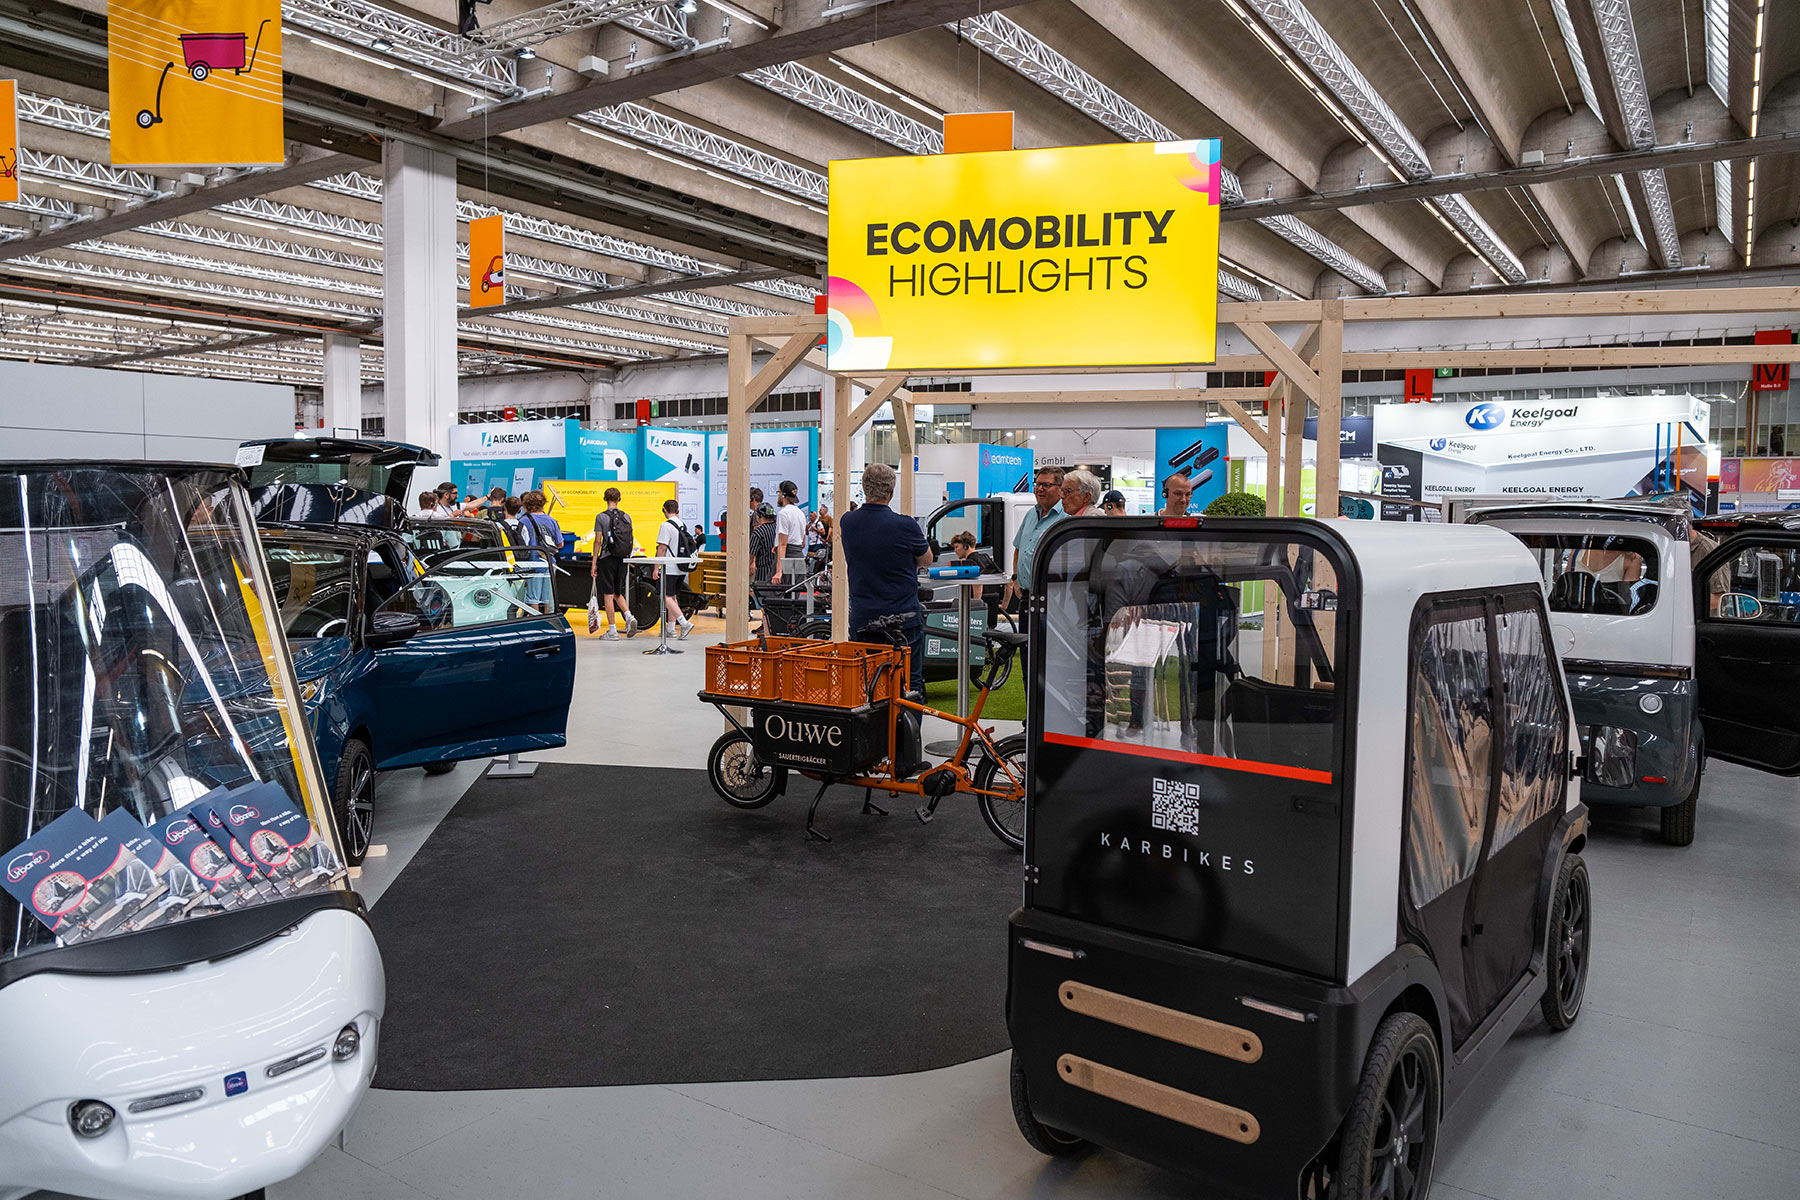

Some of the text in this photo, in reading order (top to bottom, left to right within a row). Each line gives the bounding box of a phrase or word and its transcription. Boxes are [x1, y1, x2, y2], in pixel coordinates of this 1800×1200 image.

[866, 209, 1176, 256] ECOMOBILITY
[889, 255, 1148, 297] HIGHLIGHTS
[1756, 364, 1786, 382] M
[1412, 376, 1426, 396] L
[1512, 406, 1578, 420] Keelgoal
[1510, 420, 1544, 428] Energy
[492, 434, 530, 444] AIKEMA
[1340, 430, 1356, 440] CM
[750, 446, 798, 457] EMA TSE
[1448, 440, 1476, 451] Keelgoal
[1508, 450, 1538, 460] Keelgoal
[764, 714, 842, 747] Ouwe
[778, 752, 827, 765] SAUERTEIGBÄCKER
[49, 858, 65, 869] More
[64, 848, 78, 859] than
[81, 836, 96, 846] bike,
[81, 848, 93, 857] way
[1101, 832, 1255, 875] KARBIKES
[8, 852, 44, 879] Urbaner
